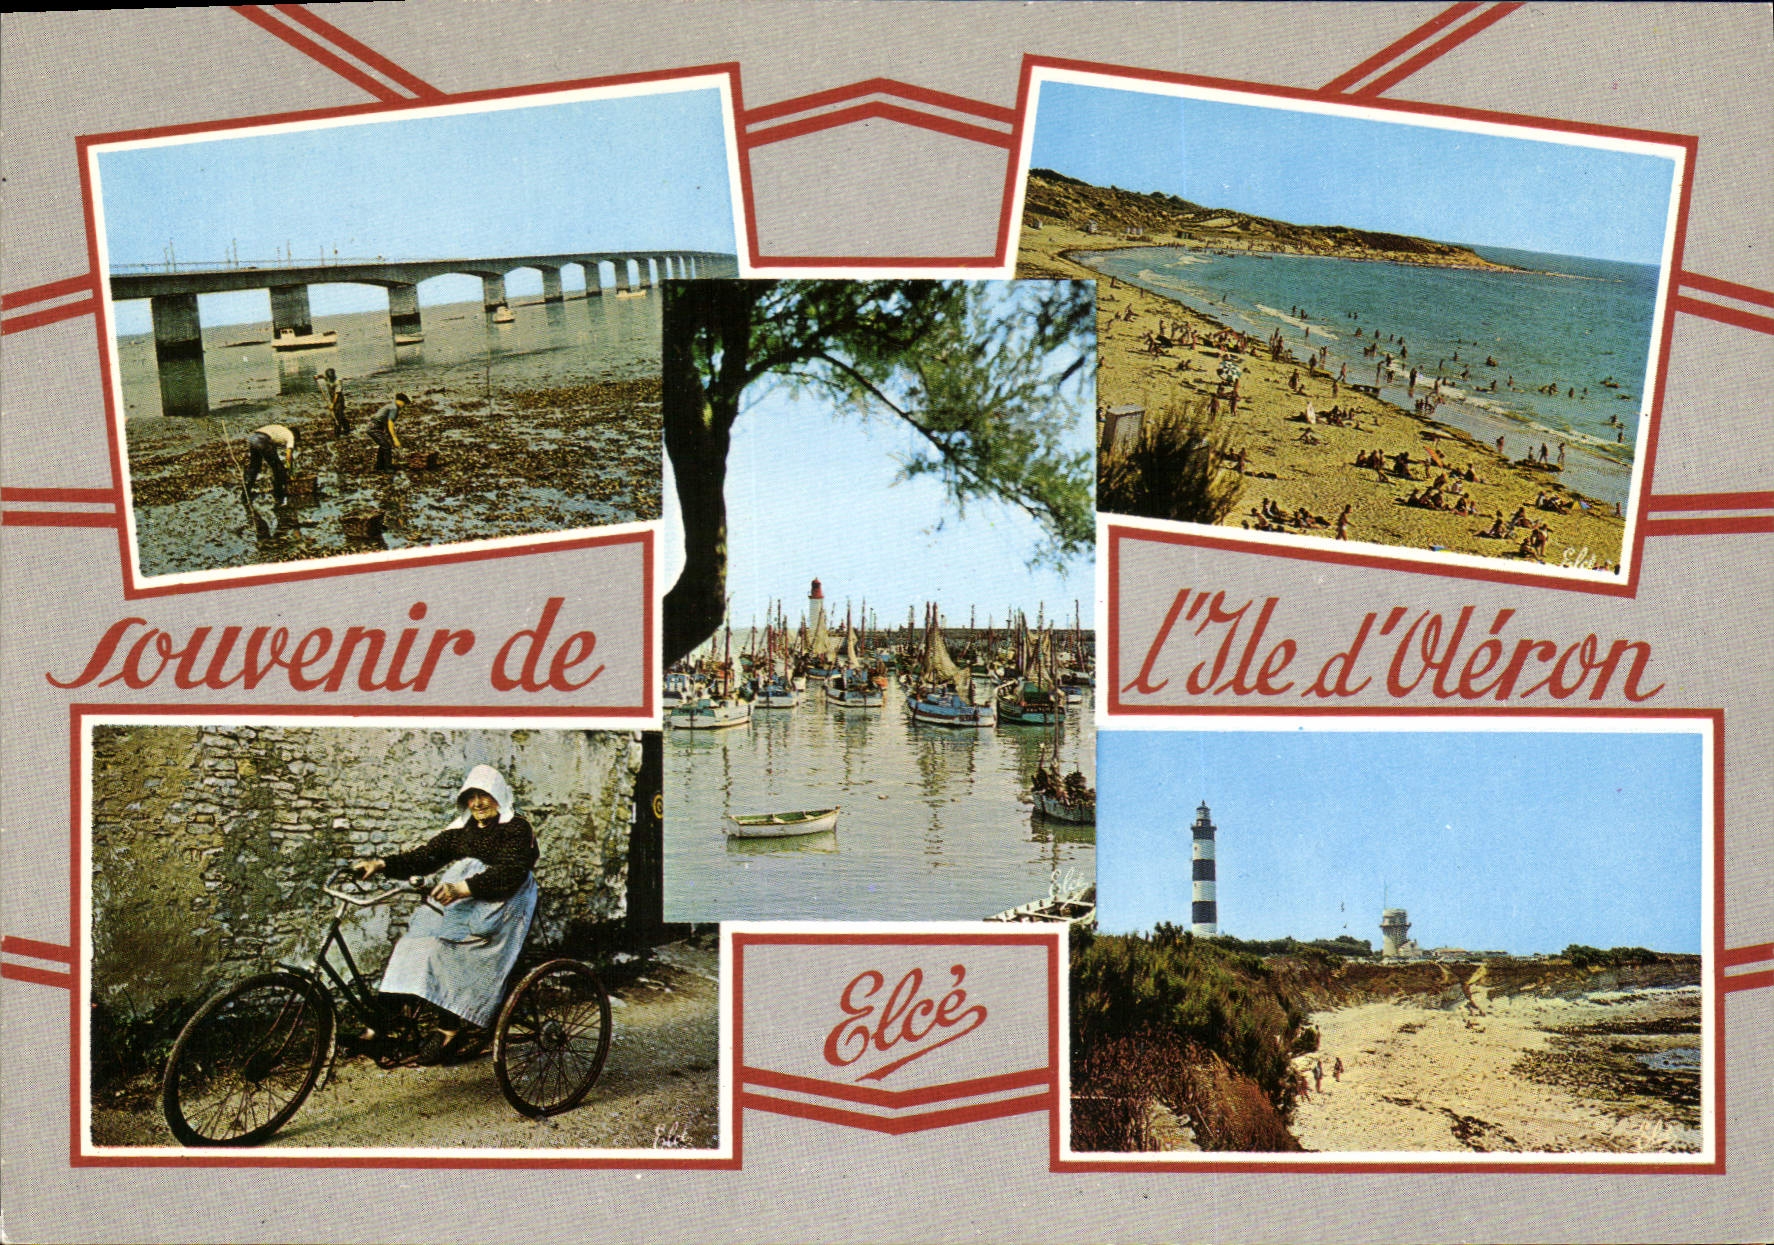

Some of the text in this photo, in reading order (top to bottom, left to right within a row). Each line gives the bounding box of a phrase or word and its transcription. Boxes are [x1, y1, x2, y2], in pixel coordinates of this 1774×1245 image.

[45, 597, 605, 693] Souvenir de
[1301, 605, 1665, 702] d'Oléron
[823, 964, 988, 1082] Elcé
